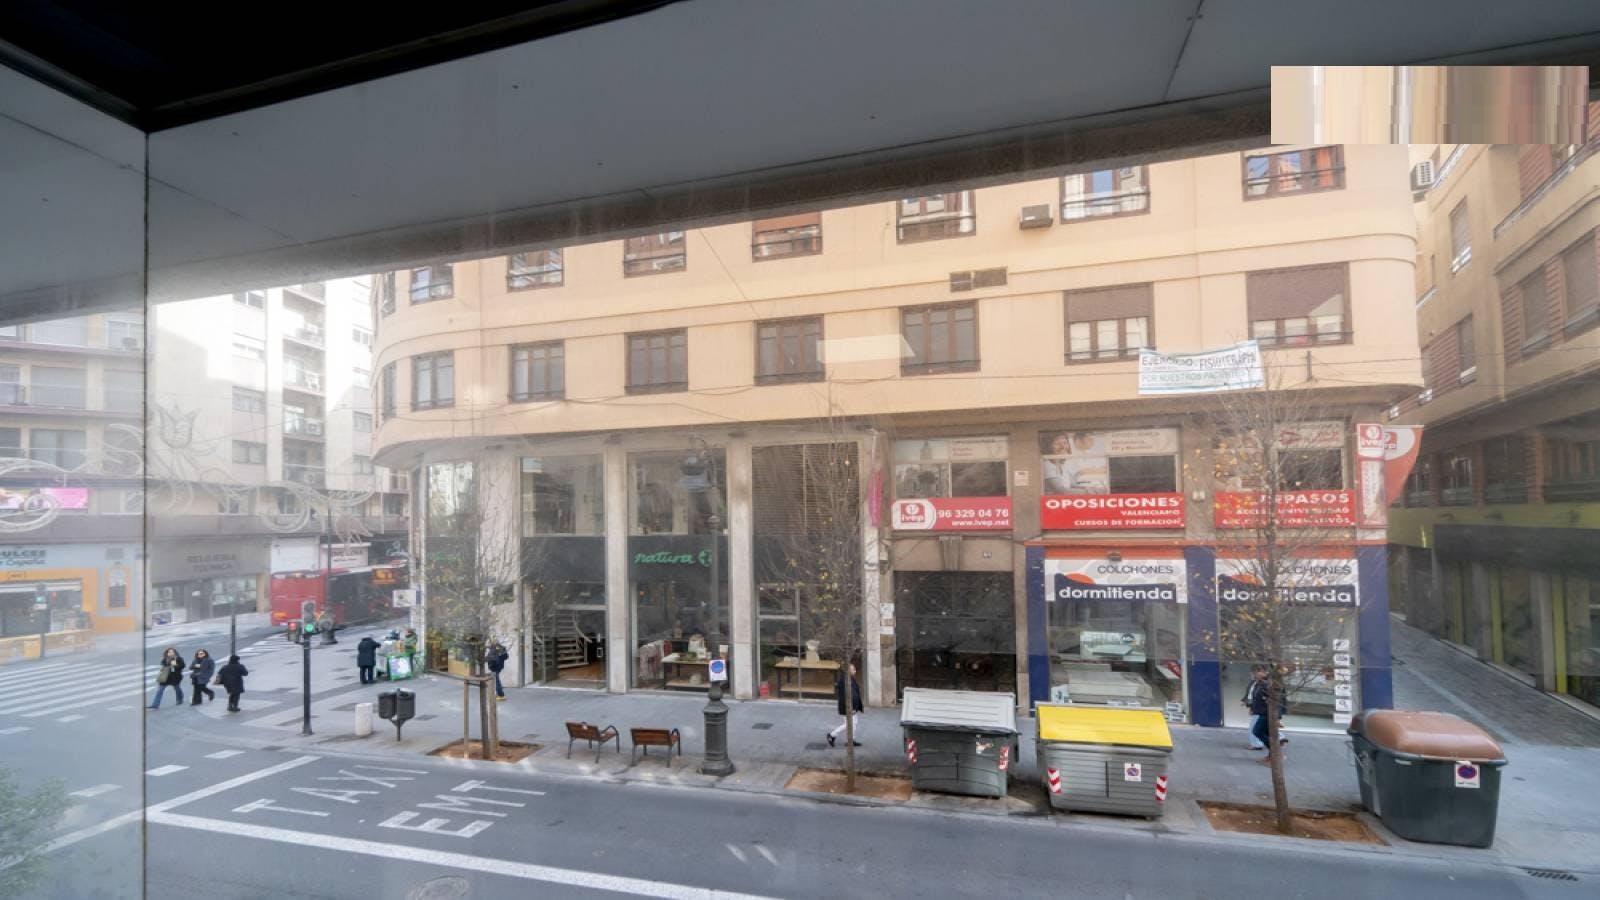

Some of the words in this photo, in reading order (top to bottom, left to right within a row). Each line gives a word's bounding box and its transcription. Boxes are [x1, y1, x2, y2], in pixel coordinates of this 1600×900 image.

[1045, 497, 1179, 509] OPOSICIONES
[938, 509, 952, 518] 96
[954, 508, 975, 518] 329
[978, 508, 992, 518] 04
[995, 508, 1009, 517] 76
[951, 519, 1009, 527] www.ivep.net
[0, 550, 46, 558] ULCES
[633, 551, 696, 567] natura
[1097, 564, 1174, 574] COLCHONES
[1058, 587, 1173, 600] dormitienda
[231, 763, 431, 817] TAXI
[376, 779, 546, 838] EMT
